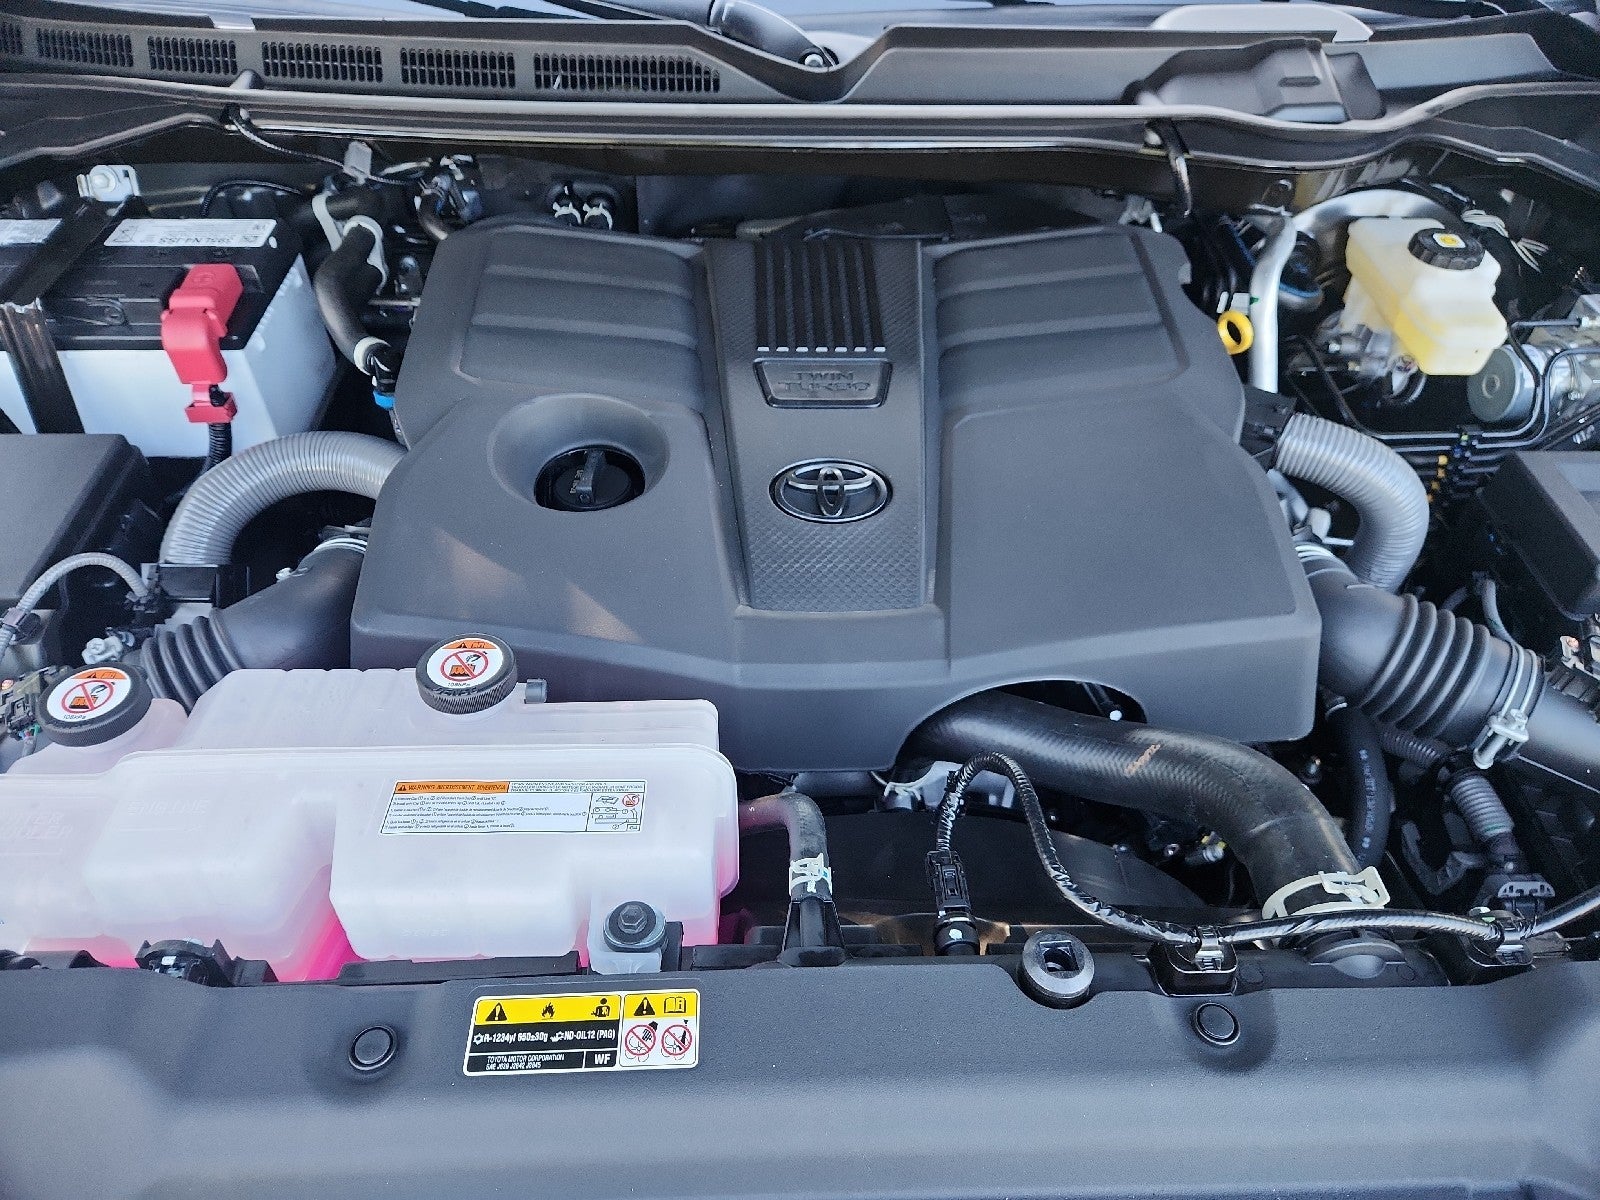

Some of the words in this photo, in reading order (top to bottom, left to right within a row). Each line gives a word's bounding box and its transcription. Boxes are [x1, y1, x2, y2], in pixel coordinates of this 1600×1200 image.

[794, 371, 854, 381] TWIN
[778, 381, 870, 392] TURBO
[596, 1029, 616, 1040] (PAG)
[487, 1055, 508, 1063] TOYOTA
[508, 1055, 527, 1063] MOTOR
[527, 1053, 565, 1062] CORPORATION
[594, 1053, 611, 1065] WF
